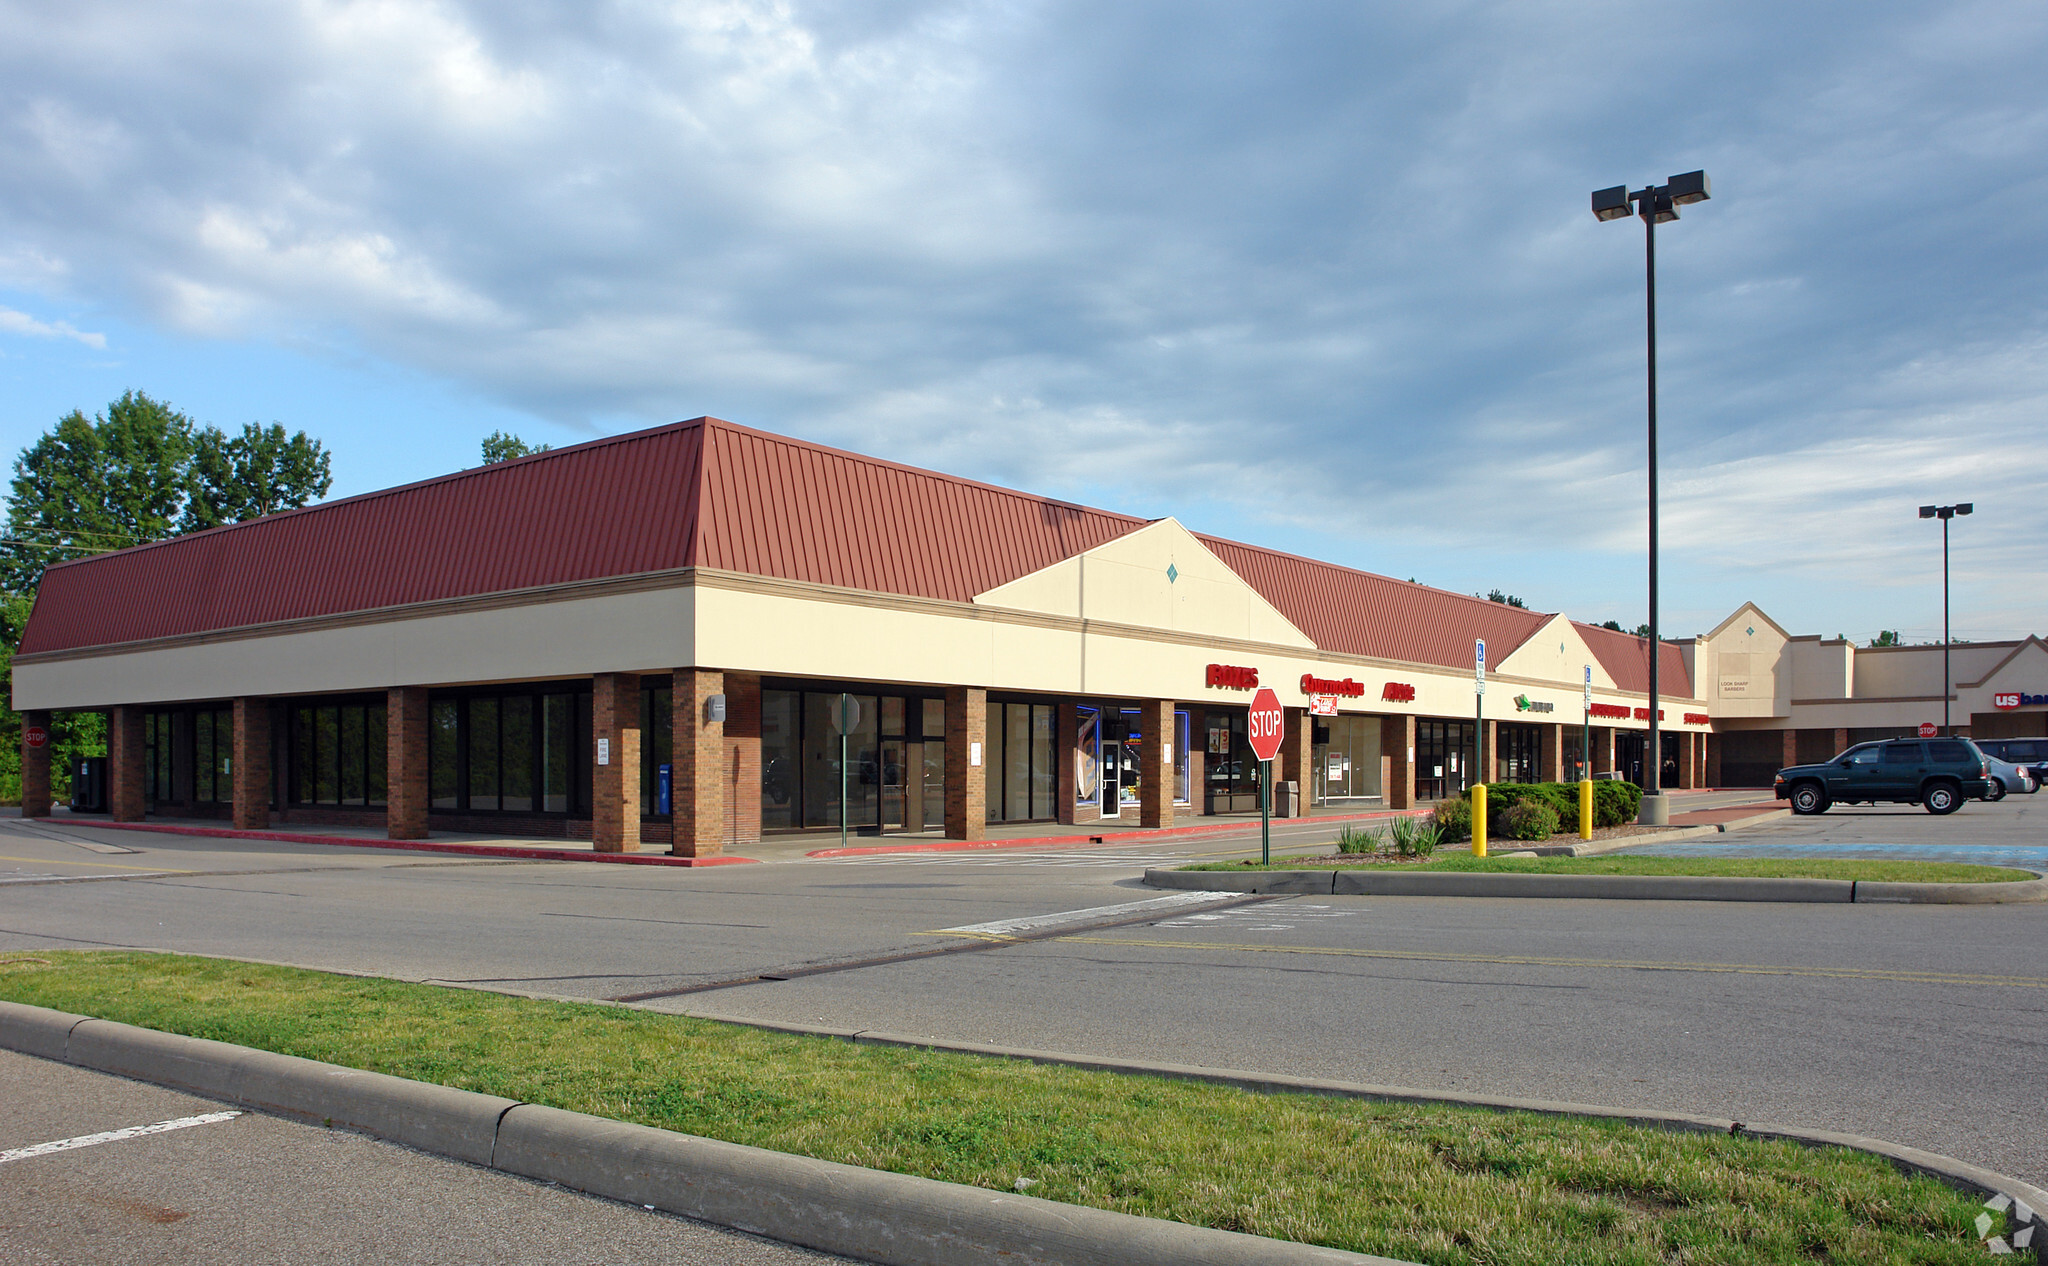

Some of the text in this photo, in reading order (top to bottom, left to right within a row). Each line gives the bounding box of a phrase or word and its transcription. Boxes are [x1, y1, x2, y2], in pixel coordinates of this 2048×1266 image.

[1206, 664, 1259, 691] BOXES
[27, 733, 46, 741] STOP
[1251, 710, 1281, 738] STOP
